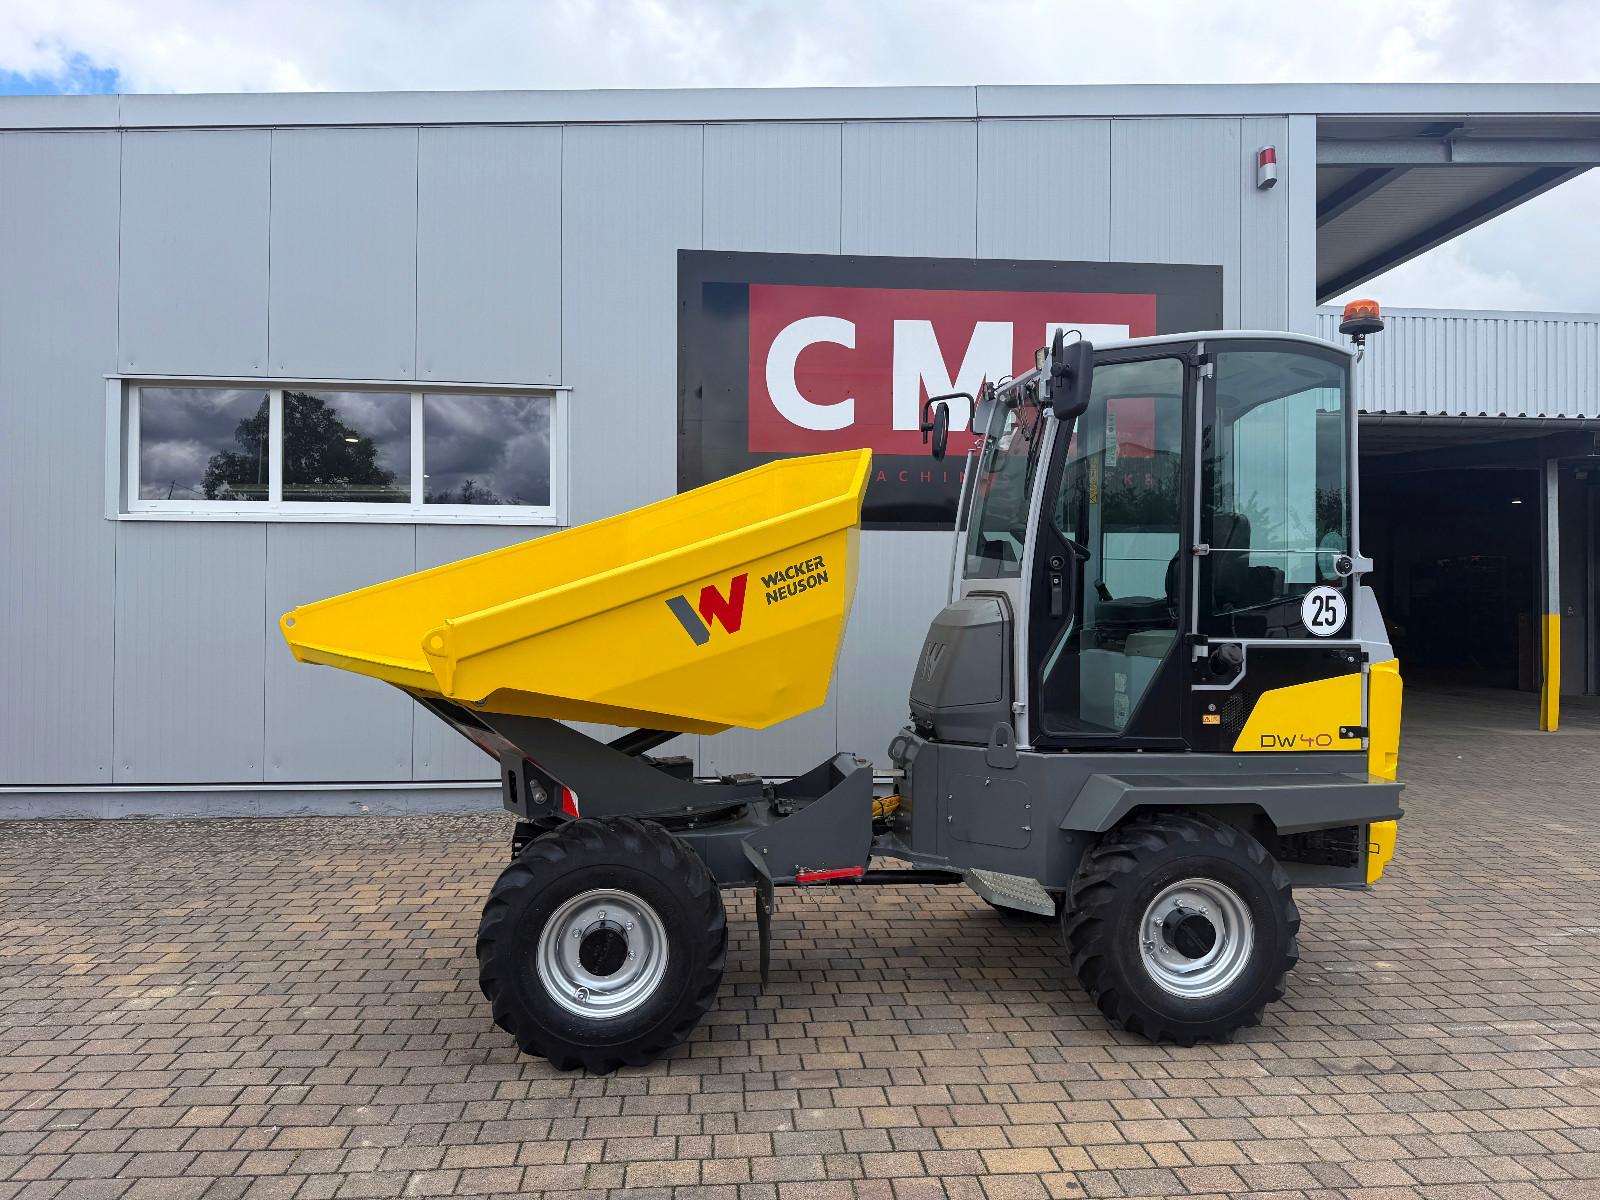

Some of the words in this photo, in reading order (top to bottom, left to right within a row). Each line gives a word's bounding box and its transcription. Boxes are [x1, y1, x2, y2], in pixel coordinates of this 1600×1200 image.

[765, 316, 1131, 431] CM
[760, 555, 825, 589] WACKER
[765, 570, 829, 606] NEUSON
[1312, 595, 1337, 627] 25
